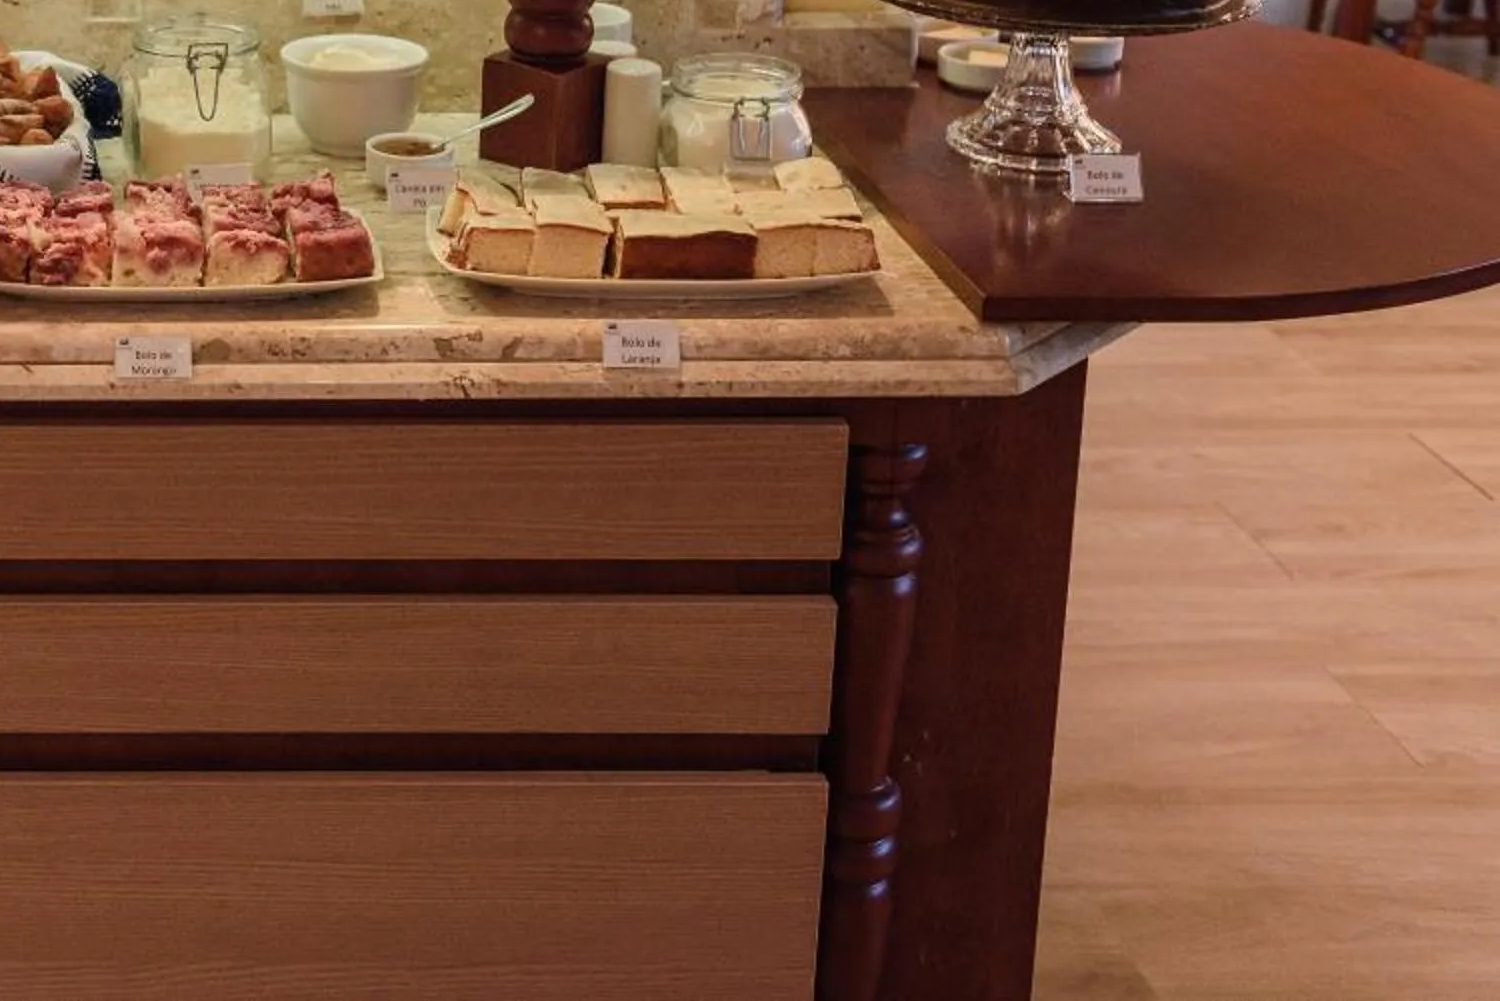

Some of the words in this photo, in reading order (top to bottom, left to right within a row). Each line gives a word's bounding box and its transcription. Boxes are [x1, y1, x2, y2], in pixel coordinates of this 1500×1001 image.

[622, 336, 645, 348] Bolo
[647, 335, 661, 348] de
[135, 350, 157, 360] Bolo
[621, 353, 661, 368] Laranja
[132, 364, 177, 377] Morango
